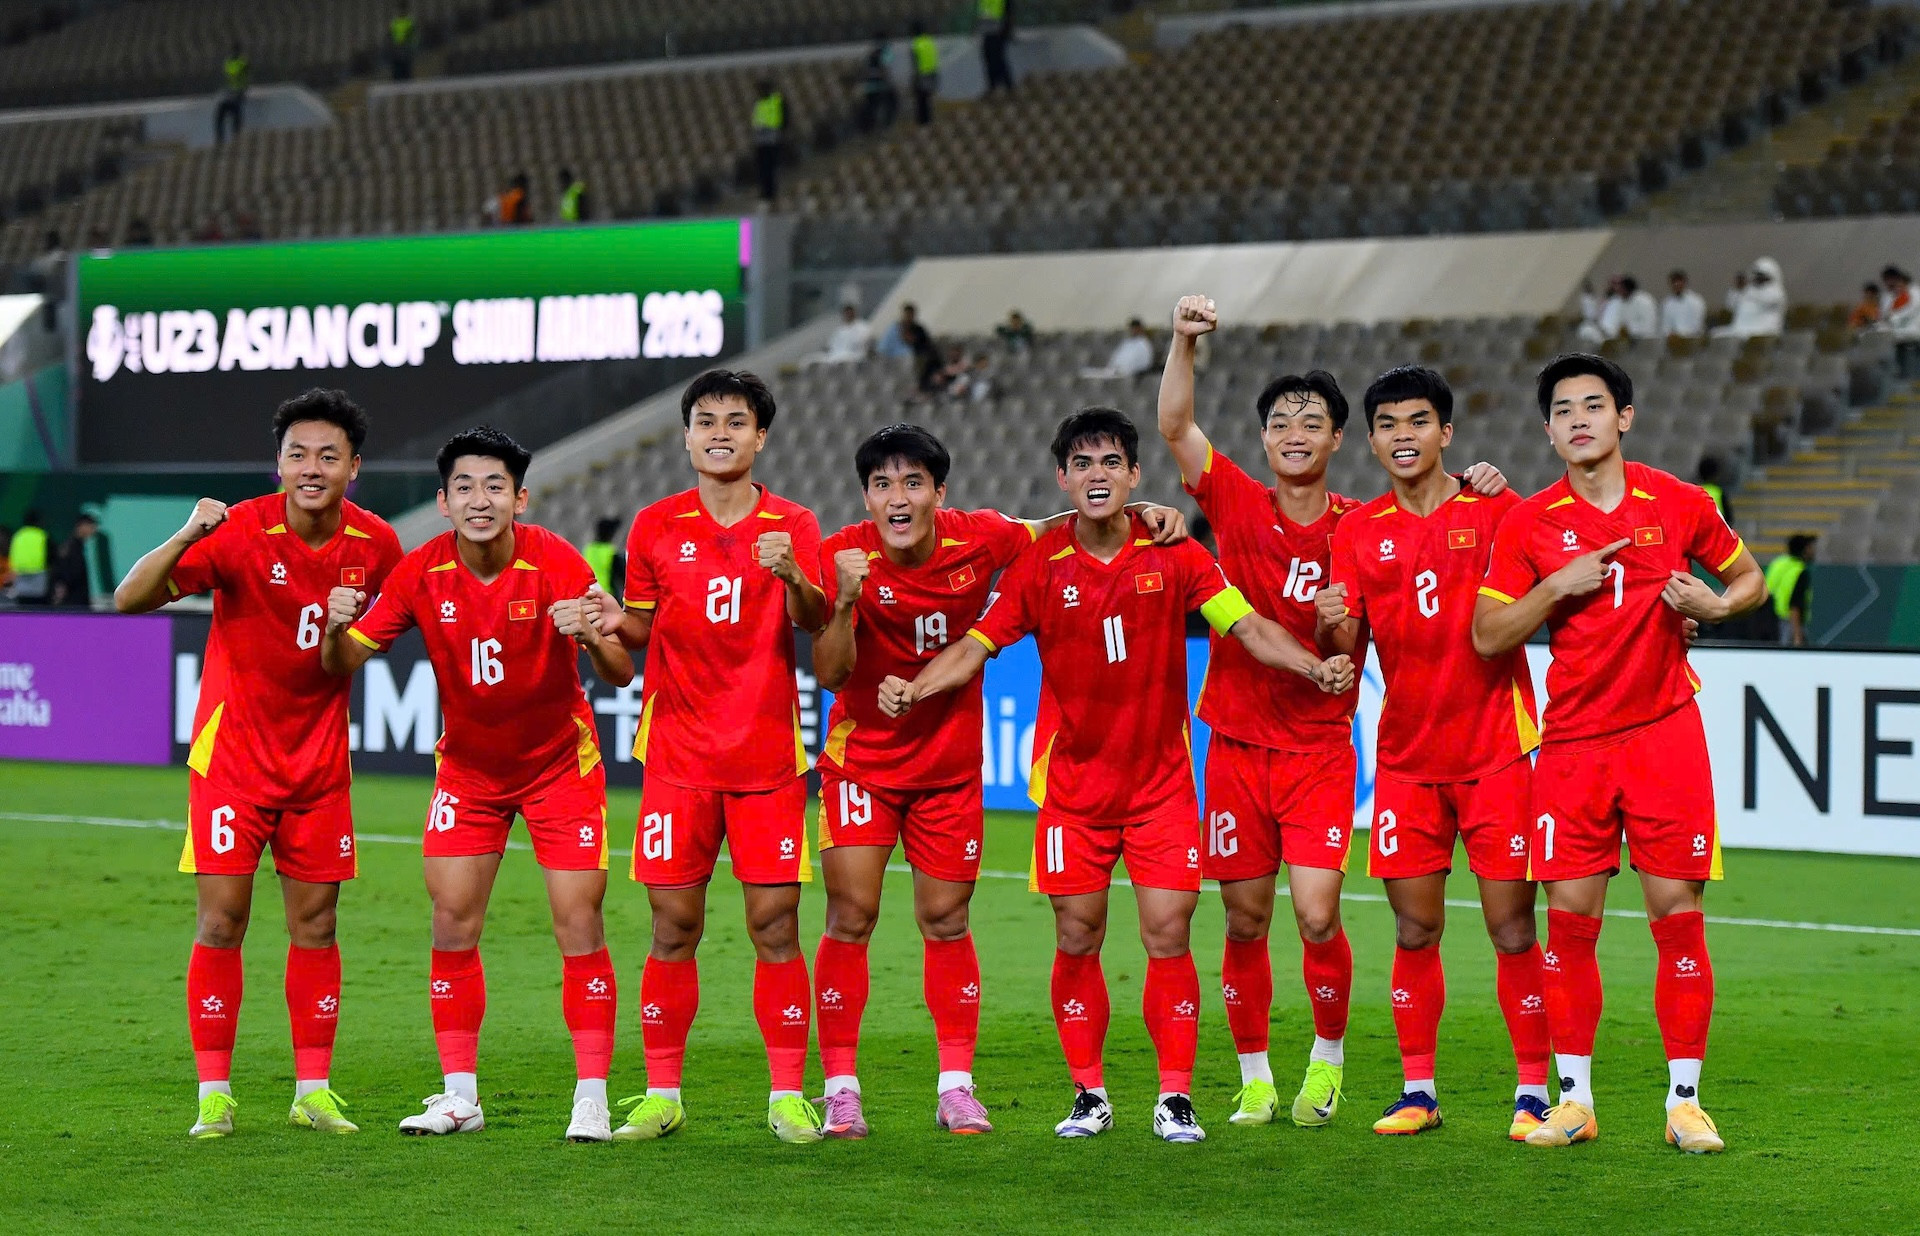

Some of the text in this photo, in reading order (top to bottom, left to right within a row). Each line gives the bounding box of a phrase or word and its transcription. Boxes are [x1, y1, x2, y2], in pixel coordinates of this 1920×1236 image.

[141, 309, 219, 374] U23
[218, 304, 348, 371] ASIAN
[347, 302, 441, 368] CUP
[706, 576, 742, 625] 21
[1283, 557, 1322, 603] 12
[1416, 568, 1439, 619] 2
[1607, 560, 1625, 610] 7
[296, 602, 323, 651] 6
[915, 611, 947, 656] 19
[1102, 614, 1127, 665] 11
[472, 637, 504, 686] 16
[1742, 683, 1920, 818] NE
[427, 788, 459, 832] 16
[839, 780, 872, 827] 19
[211, 805, 235, 854] 6
[643, 812, 672, 861] 21
[1047, 825, 1064, 873] 11
[1209, 810, 1238, 858] 12
[1379, 809, 1398, 857] 2
[1537, 814, 1555, 861] 7
